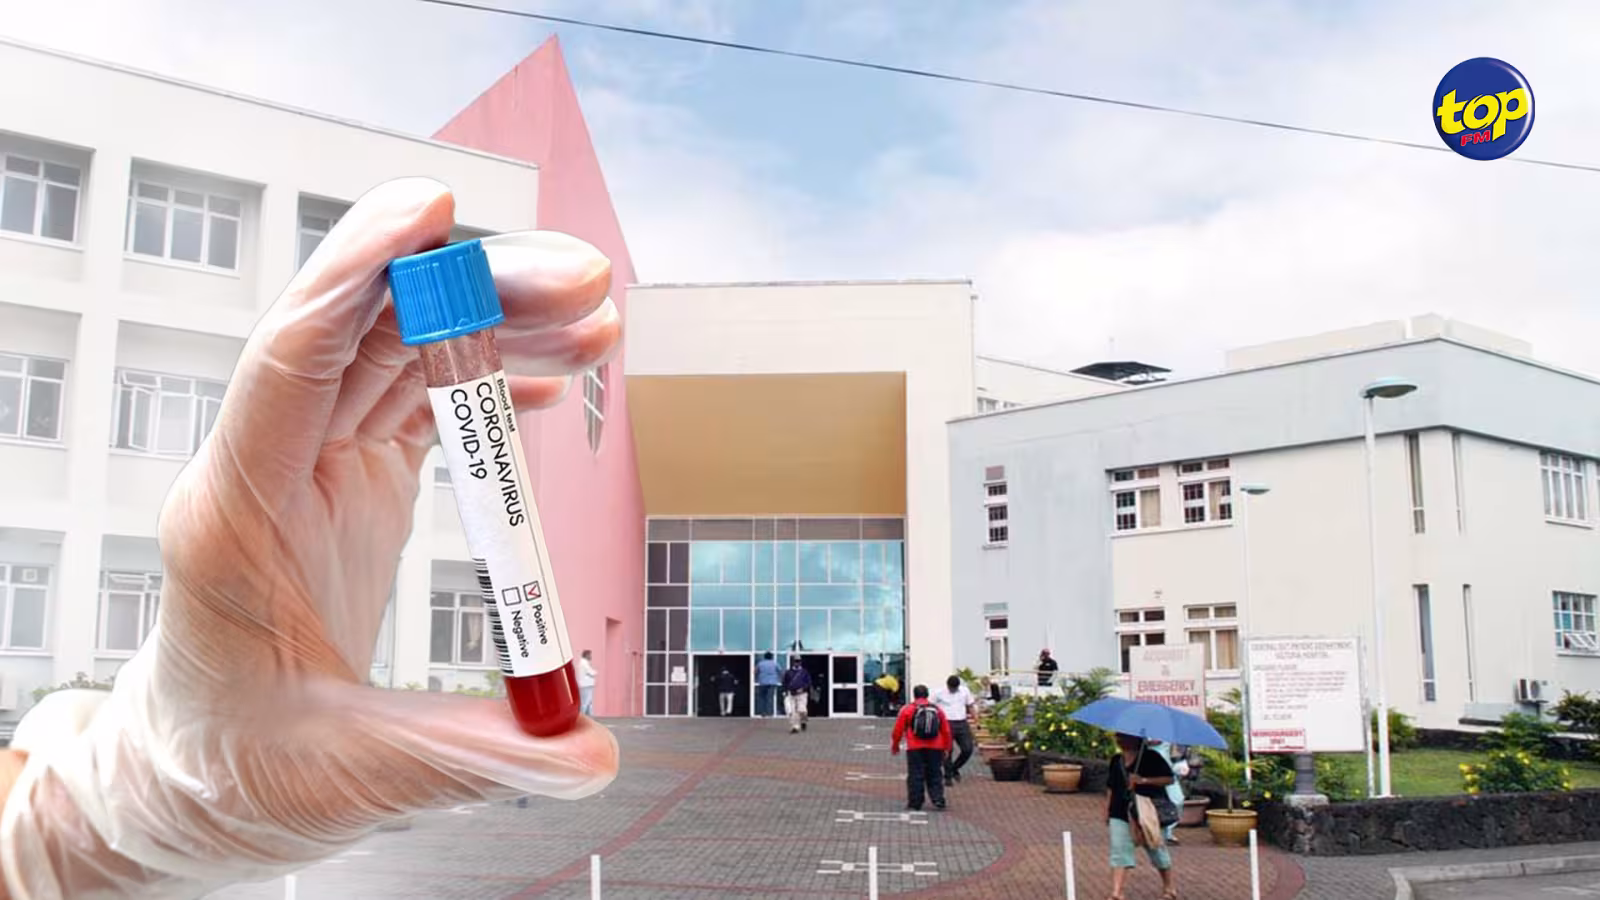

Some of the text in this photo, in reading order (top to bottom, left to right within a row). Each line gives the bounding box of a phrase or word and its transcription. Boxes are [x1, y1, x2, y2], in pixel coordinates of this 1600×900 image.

[497, 378, 516, 433] Blood test
[451, 388, 488, 480] COVID-19
[476, 381, 525, 527] CORONAVIRUS
[511, 610, 530, 658] Negative
[532, 603, 548, 645] Positive
[1138, 680, 1195, 693] EMERGENCY
